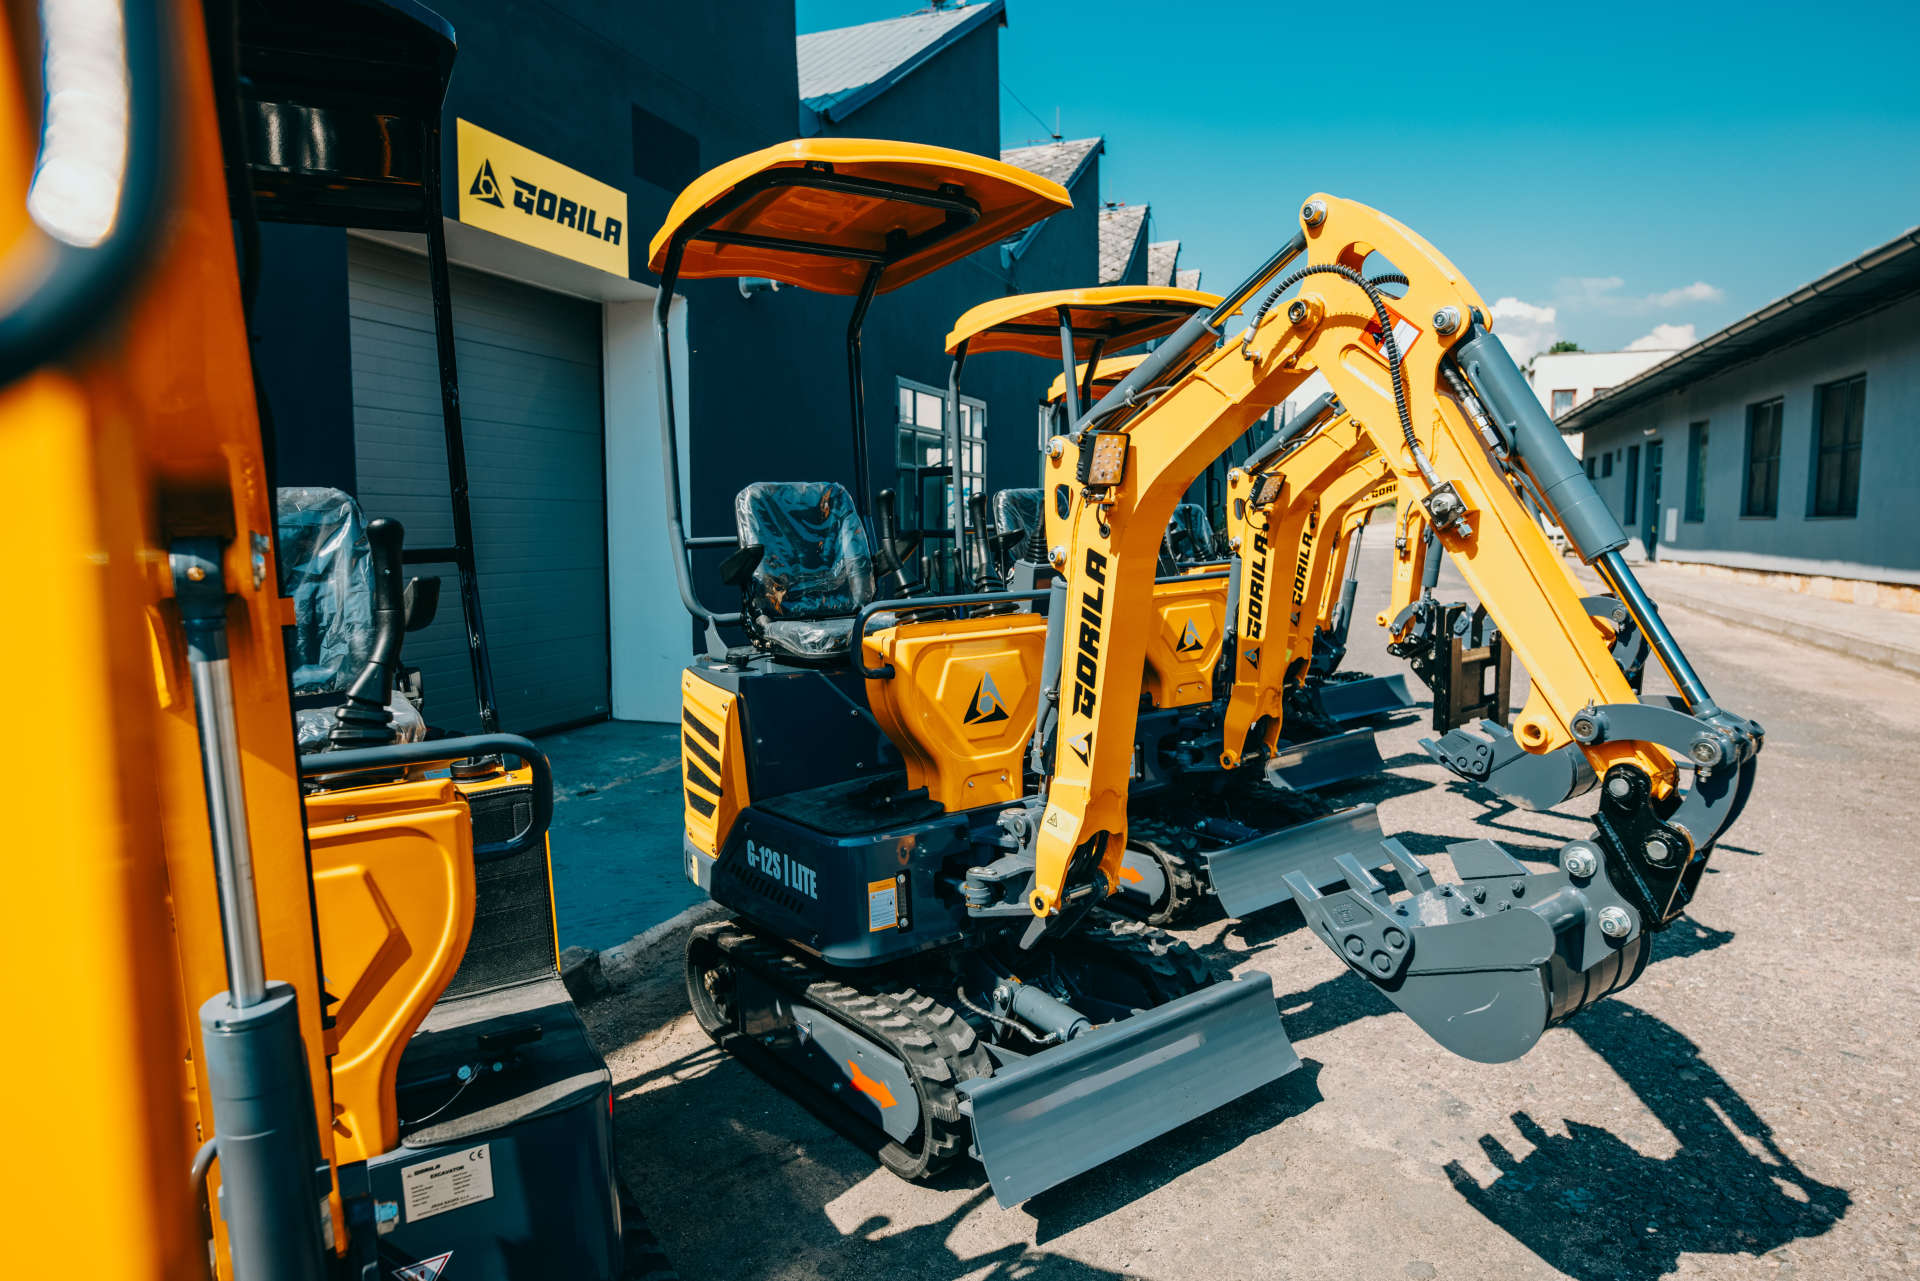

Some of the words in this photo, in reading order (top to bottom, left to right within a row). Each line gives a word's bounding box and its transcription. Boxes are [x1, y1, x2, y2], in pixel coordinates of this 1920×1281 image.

[511, 176, 622, 246] GORILA
[1246, 534, 1268, 639] GORILA
[1292, 533, 1313, 606] GORILA
[1073, 548, 1107, 719] GORILA
[747, 840, 780, 880] G-12S
[792, 860, 817, 900] LITE
[430, 1165, 464, 1179] EXCAVATOR
